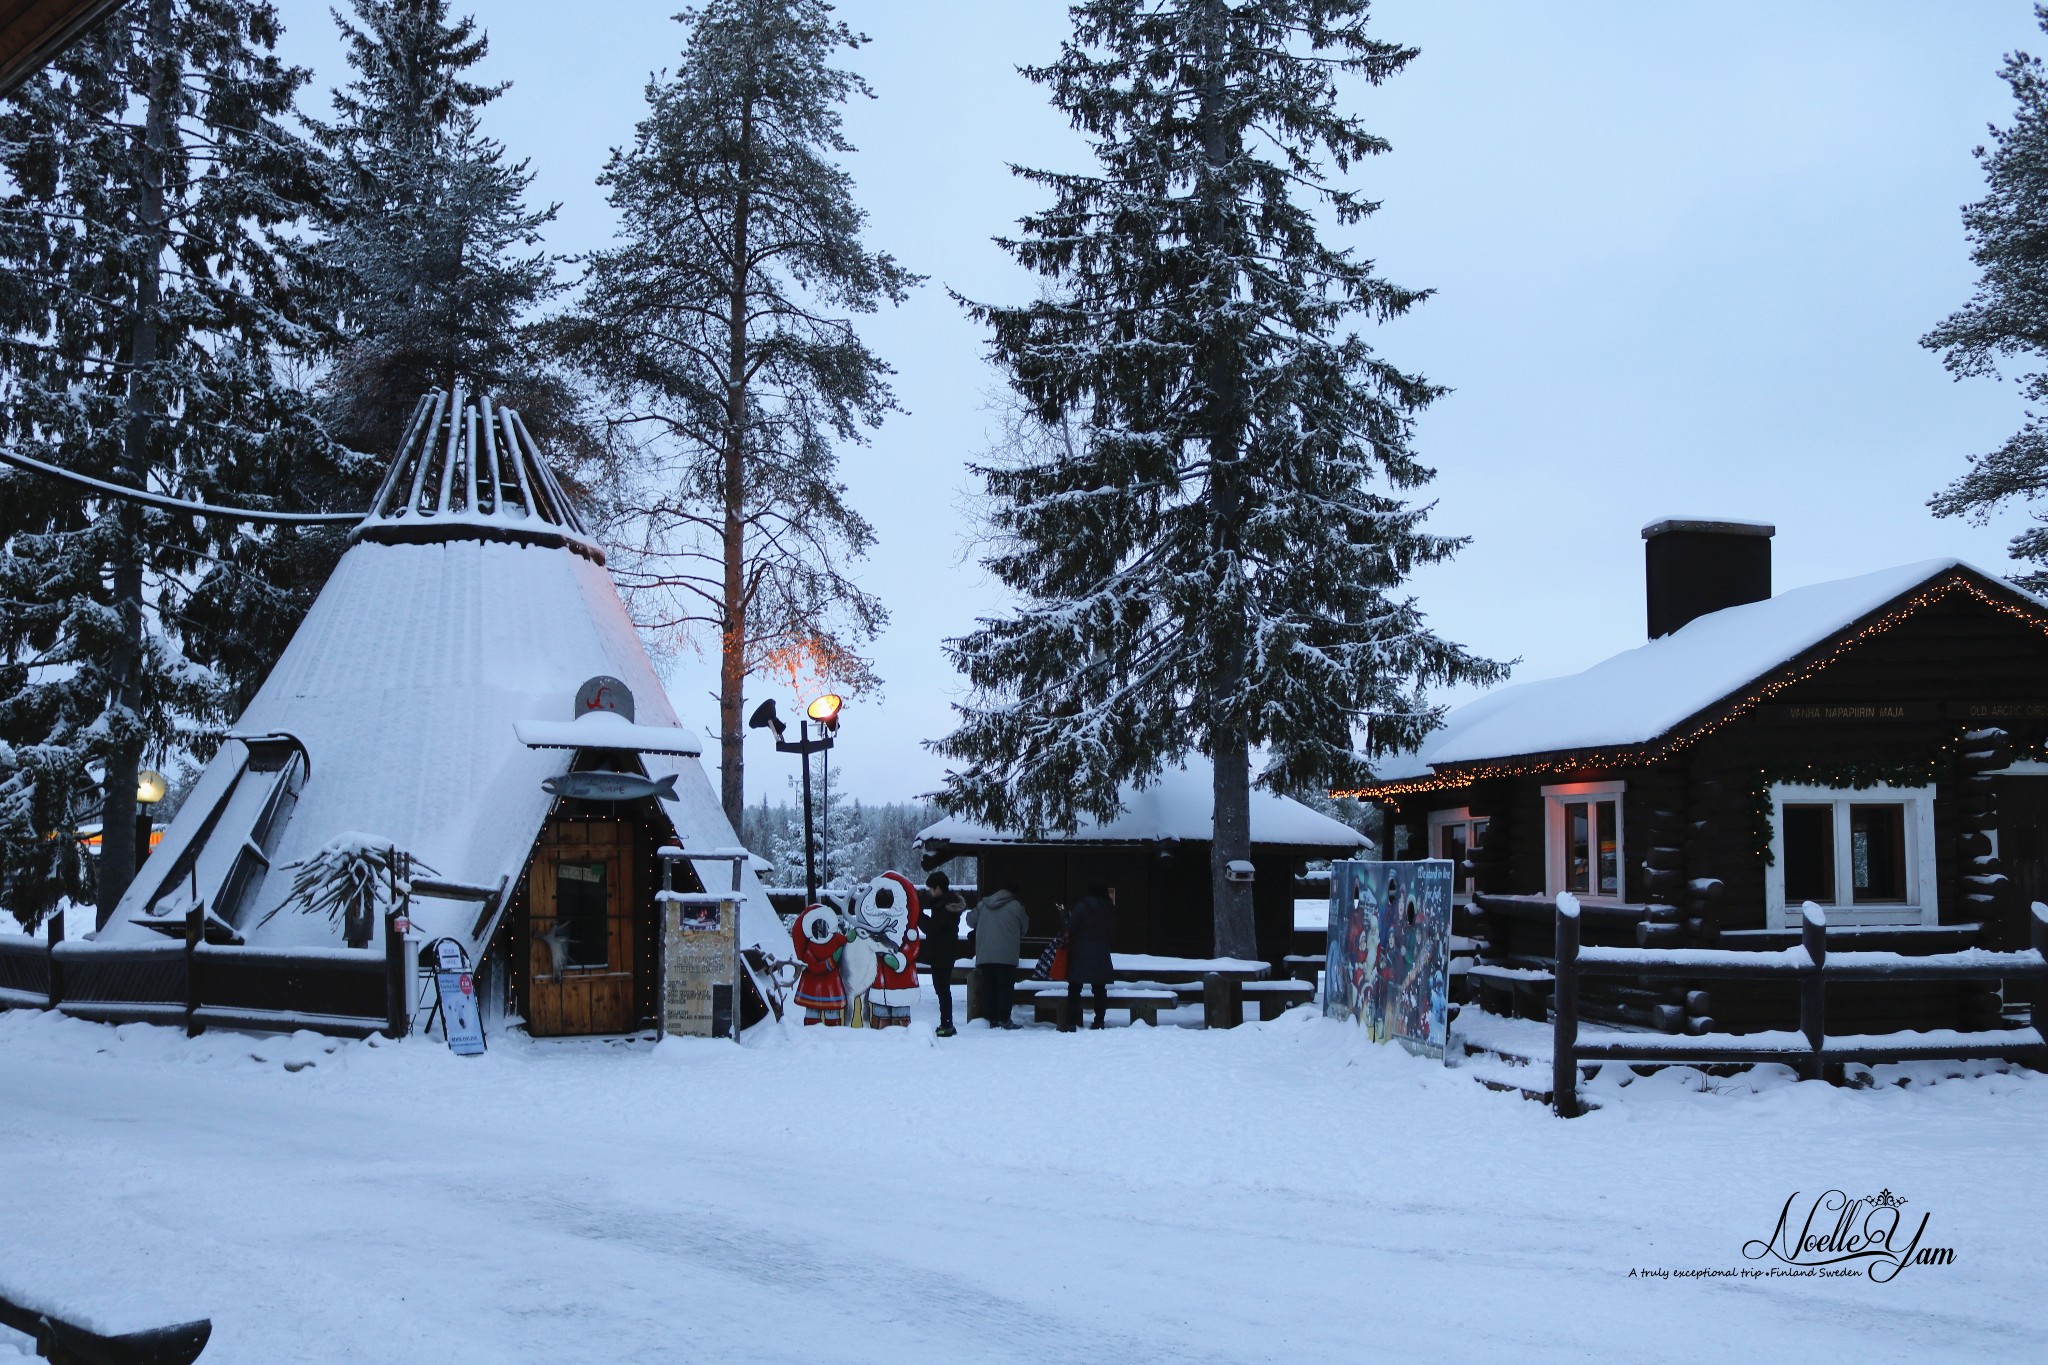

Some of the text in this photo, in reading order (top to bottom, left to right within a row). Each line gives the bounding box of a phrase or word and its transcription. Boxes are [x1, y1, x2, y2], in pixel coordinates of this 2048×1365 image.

[1790, 706, 1904, 719] VANHA NAPAPIIRIN MAJA
[1970, 705, 2048, 716] OLD ARCTIC CIRC
